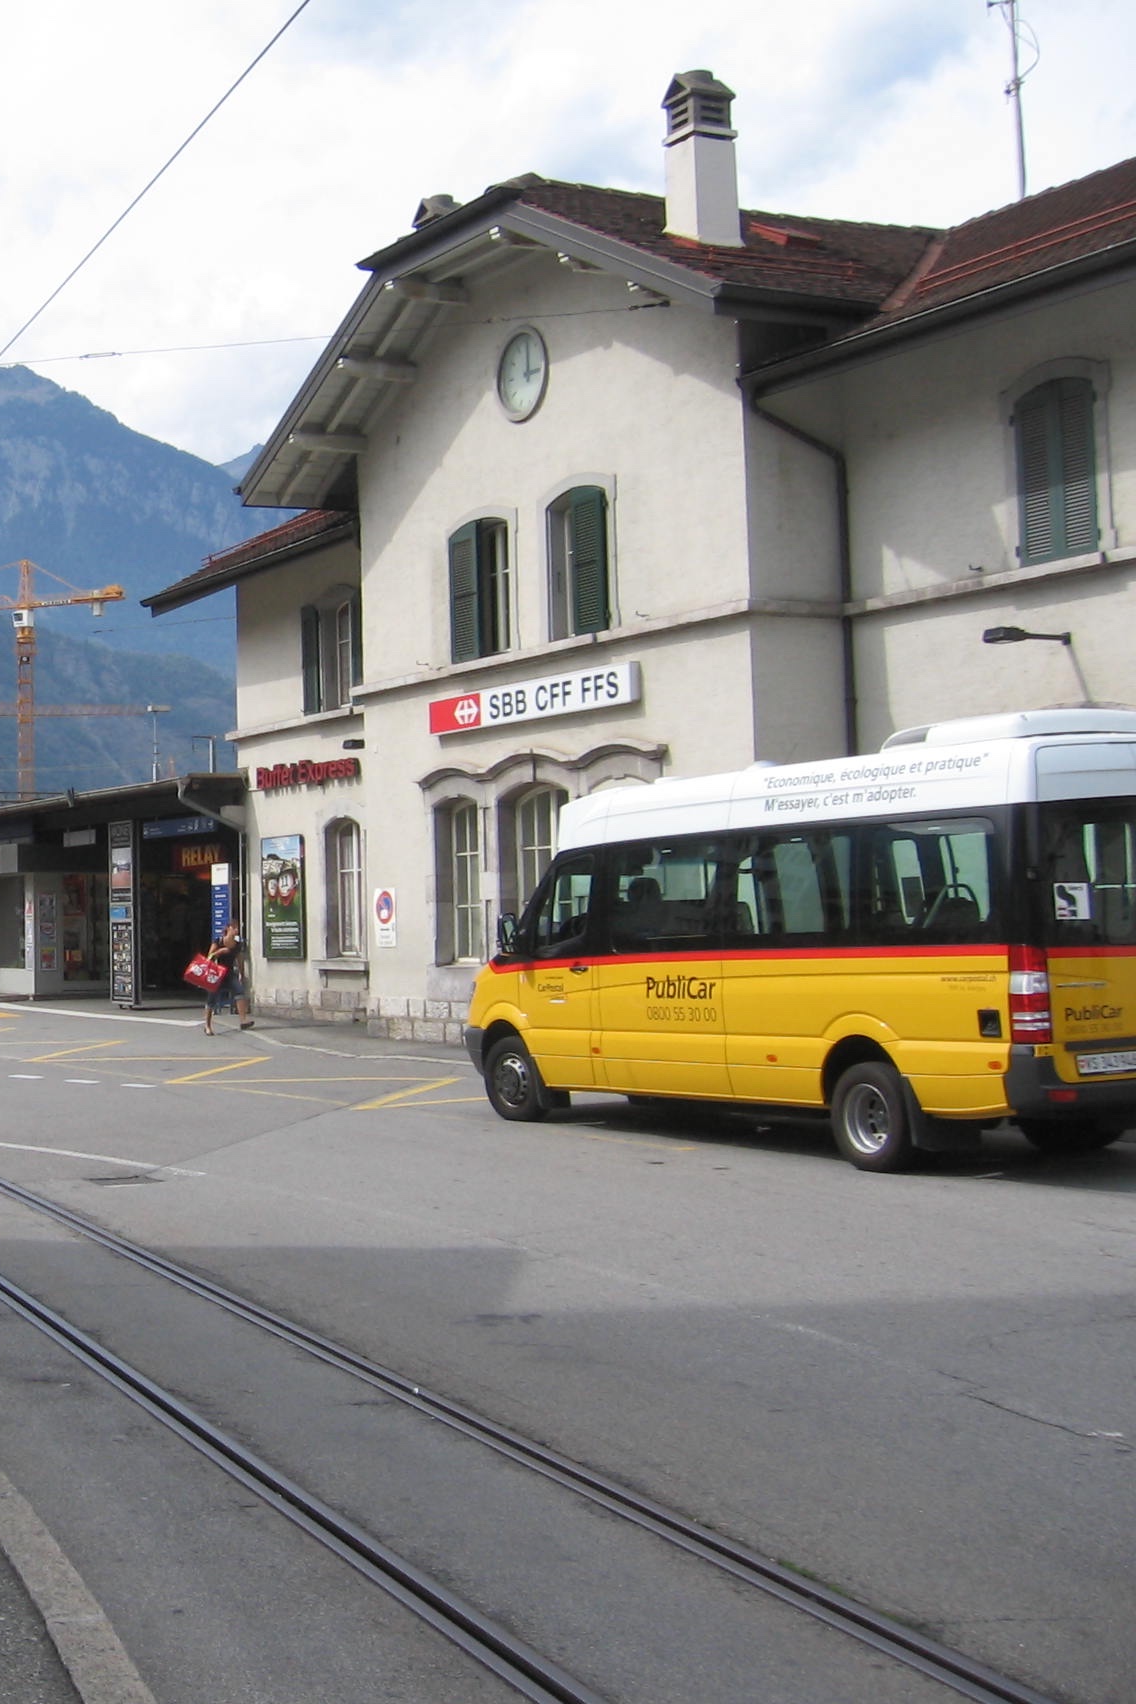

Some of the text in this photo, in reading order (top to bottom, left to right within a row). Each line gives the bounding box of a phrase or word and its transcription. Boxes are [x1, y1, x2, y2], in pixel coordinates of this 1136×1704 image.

[489, 671, 619, 720] SBB CFF FFS
[257, 757, 356, 790] Buffet Express
[840, 763, 907, 782] écologique
[909, 760, 923, 774] et
[763, 786, 917, 813] M'essayer, c'est m'adopter.
[182, 844, 220, 868] RELAY
[645, 975, 716, 1000] PubliCar
[647, 1005, 717, 1022] 0800 55 30 00
[1064, 1004, 1123, 1022] PubliCar
